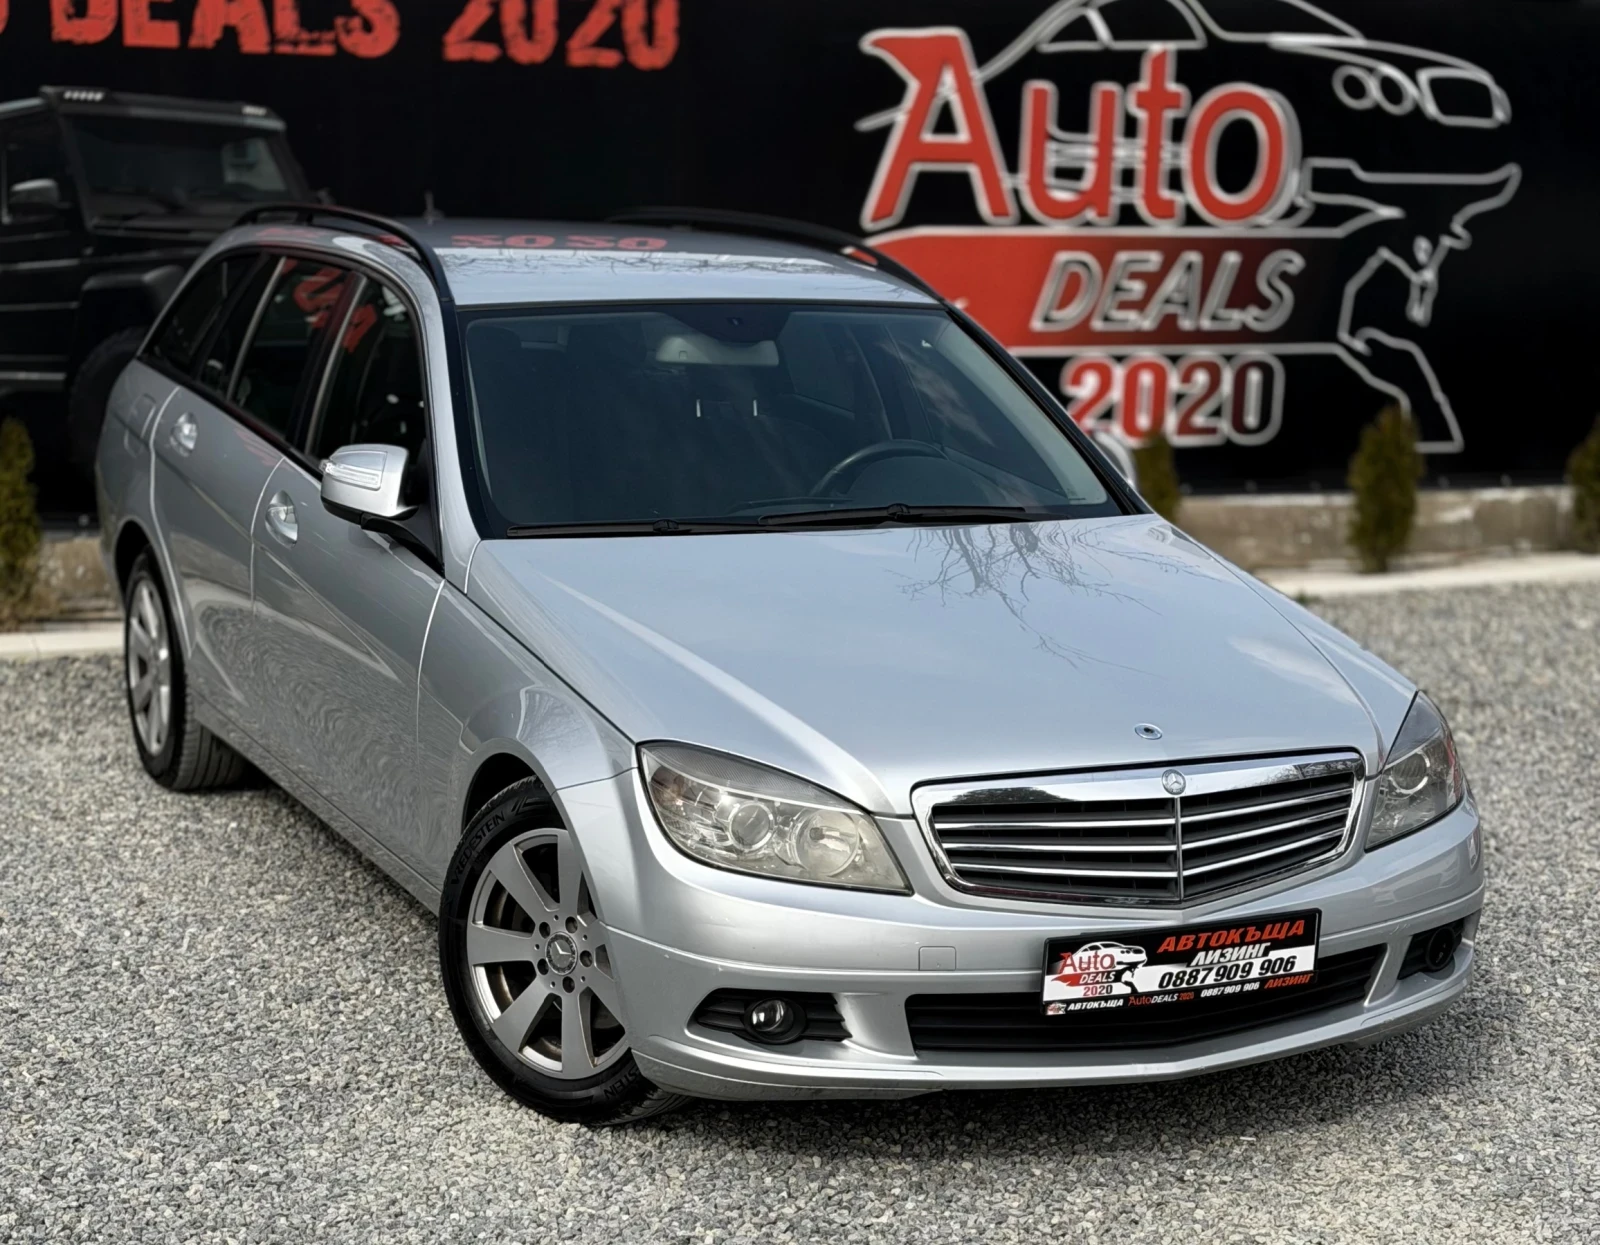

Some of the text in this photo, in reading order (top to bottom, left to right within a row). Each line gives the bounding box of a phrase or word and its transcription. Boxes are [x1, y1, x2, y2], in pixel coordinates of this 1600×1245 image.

[860, 27, 1292, 229] Auto
[1030, 251, 1304, 332] DEALS
[1061, 352, 1285, 446] 2020
[1157, 919, 1305, 953] АВТОКЪЩА
[1059, 950, 1115, 974] Auto
[1190, 942, 1271, 967] ЛИЗИНГ
[1258, 955, 1297, 976] 906
[1067, 998, 1124, 1011] АВТОКЪЩА
[1264, 973, 1314, 990] ЛИЗИНГ
[1079, 971, 1116, 984] DEALS
[1082, 984, 1113, 997] 2020
